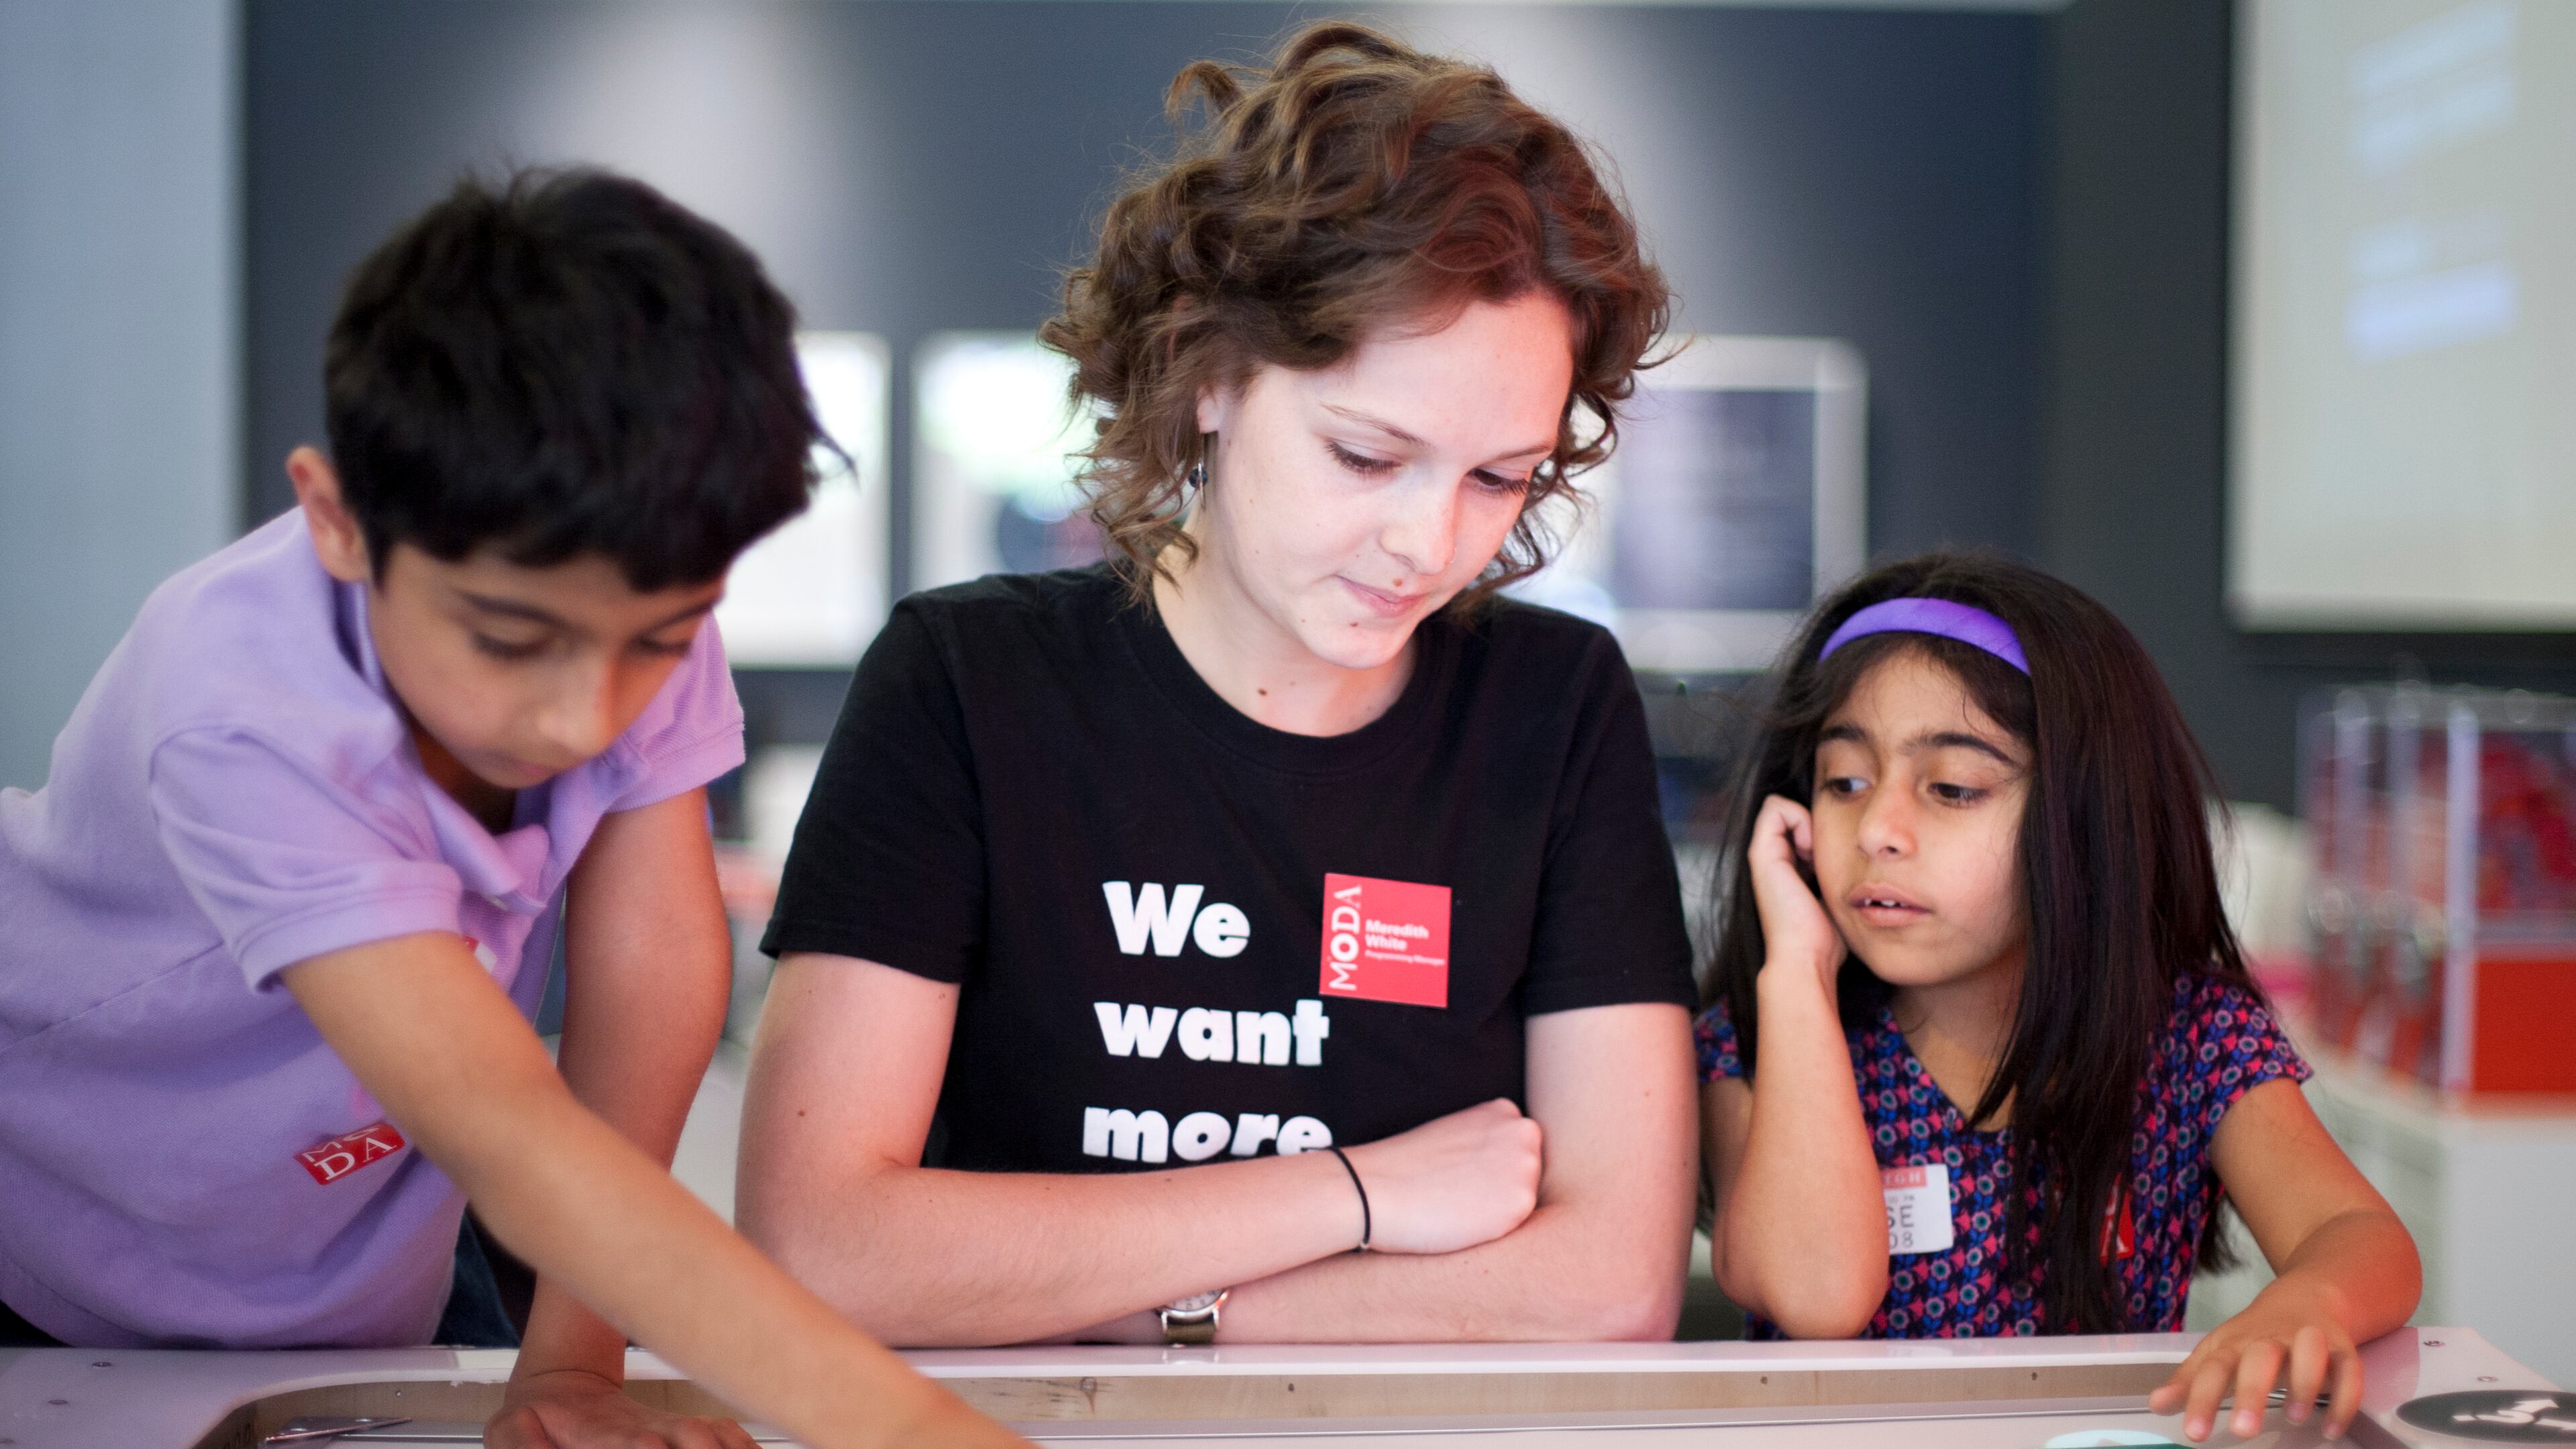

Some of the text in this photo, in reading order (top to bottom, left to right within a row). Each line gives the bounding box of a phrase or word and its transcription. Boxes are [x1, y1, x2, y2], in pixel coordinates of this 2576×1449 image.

[1102, 881, 1250, 958] We
[1329, 883, 1362, 991] MODA
[1364, 933, 1407, 951] White
[1365, 919, 1430, 938] Meredith
[1093, 1000, 1330, 1066] want
[313, 1137, 397, 1180] DA
[1082, 1107, 1332, 1163] more
[1884, 1171, 1920, 1185] IGH
